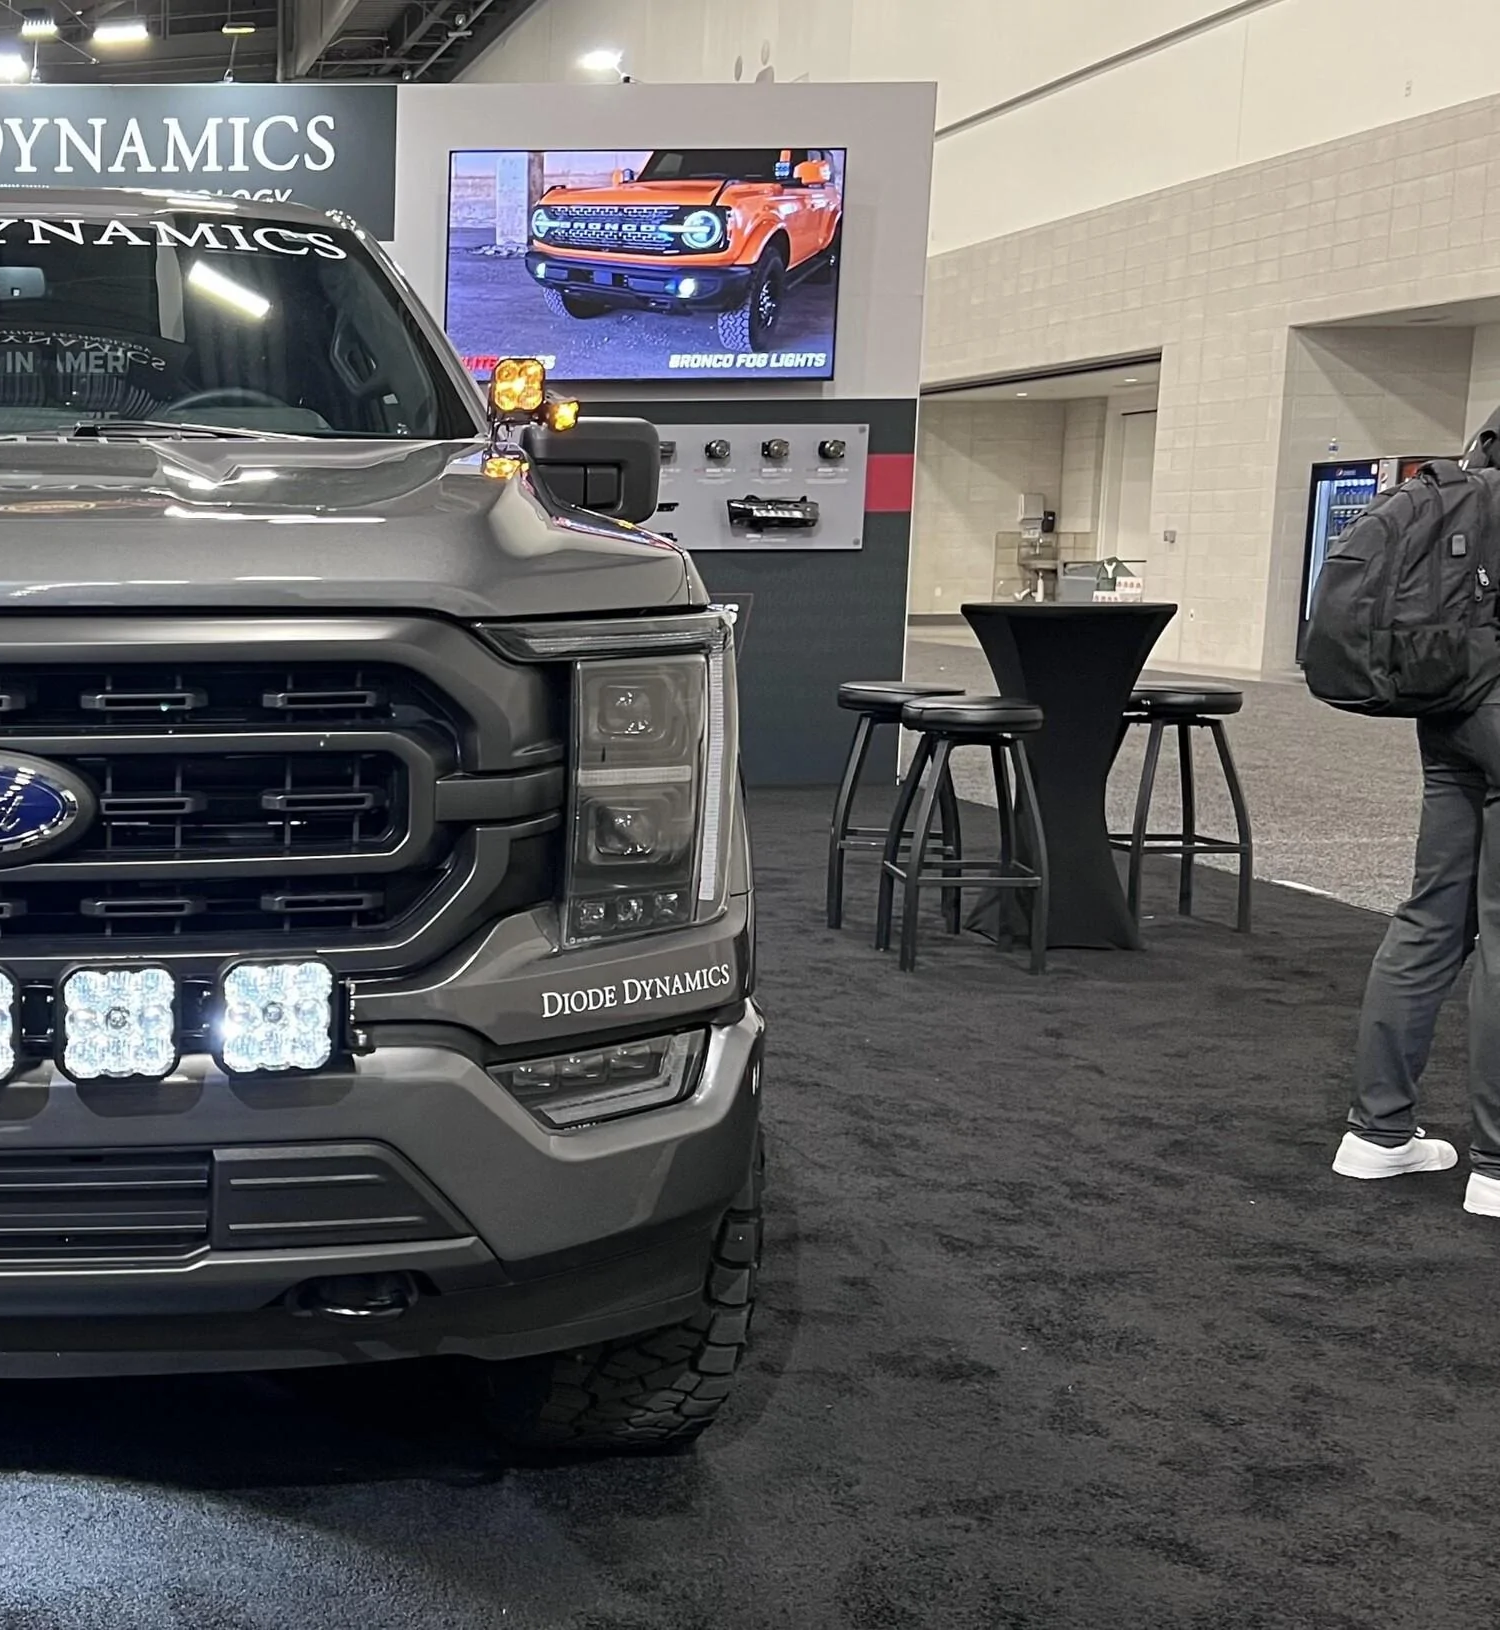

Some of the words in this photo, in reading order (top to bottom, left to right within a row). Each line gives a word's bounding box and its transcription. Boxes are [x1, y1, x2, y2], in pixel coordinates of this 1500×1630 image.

[769, 352, 826, 368] LIGHTS
[541, 985, 618, 1018] DIODE
[622, 963, 730, 1004] DYNAMICS
